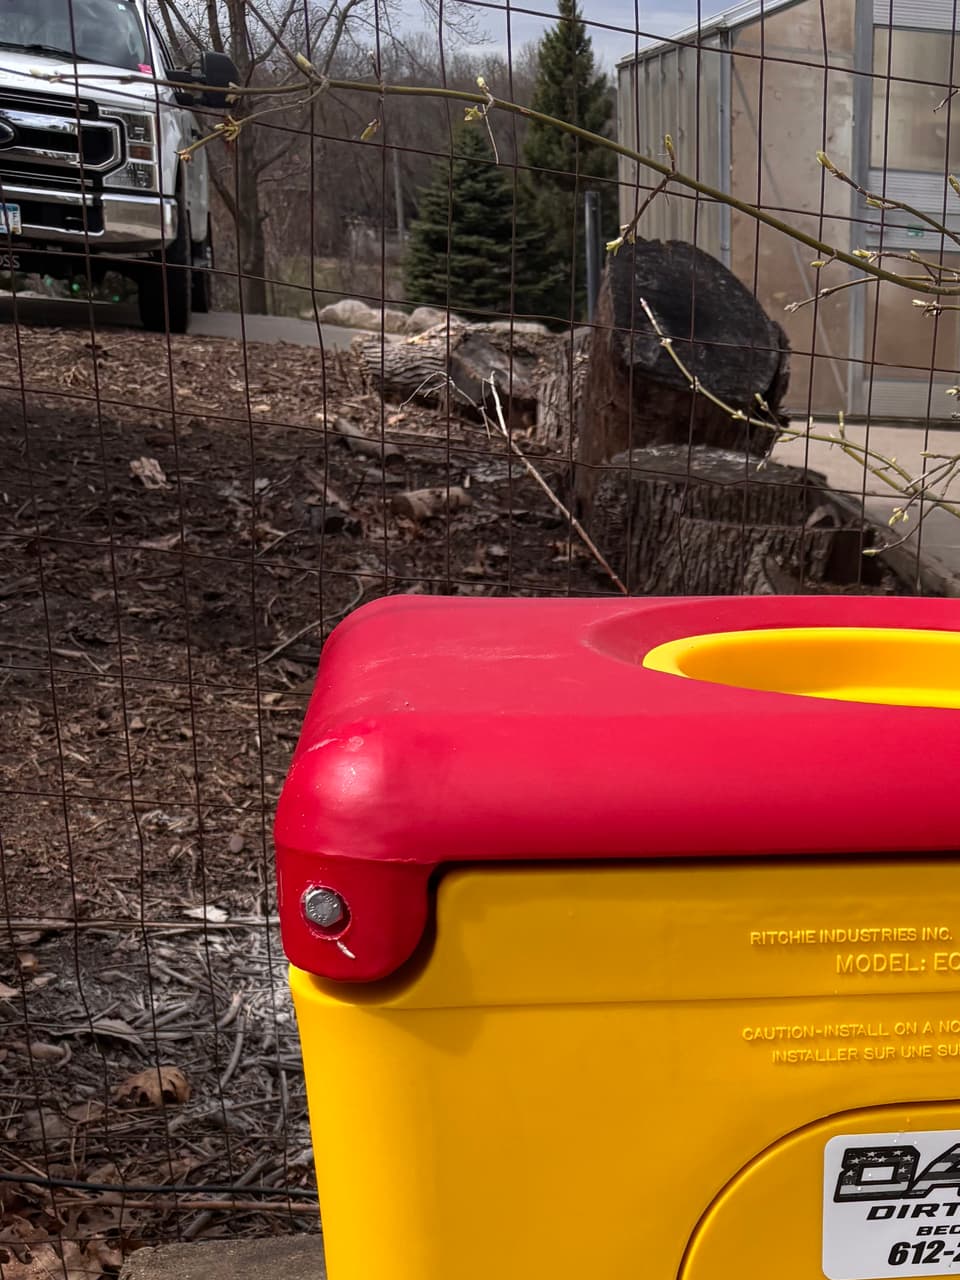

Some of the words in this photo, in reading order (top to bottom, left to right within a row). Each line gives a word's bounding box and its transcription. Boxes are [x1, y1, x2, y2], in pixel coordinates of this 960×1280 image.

[750, 930, 816, 945] RITCHIE
[819, 927, 917, 943] INDUSTRIES
[922, 926, 953, 941] INC.
[836, 952, 926, 973] MODEL:
[742, 1023, 889, 1041] CAUTION-INSTALL
[894, 1021, 917, 1036] ON
[922, 1020, 933, 1034] A
[772, 1047, 858, 1064] INSTALLER
[864, 1046, 896, 1061] SUR
[901, 1044, 932, 1059] UNE
